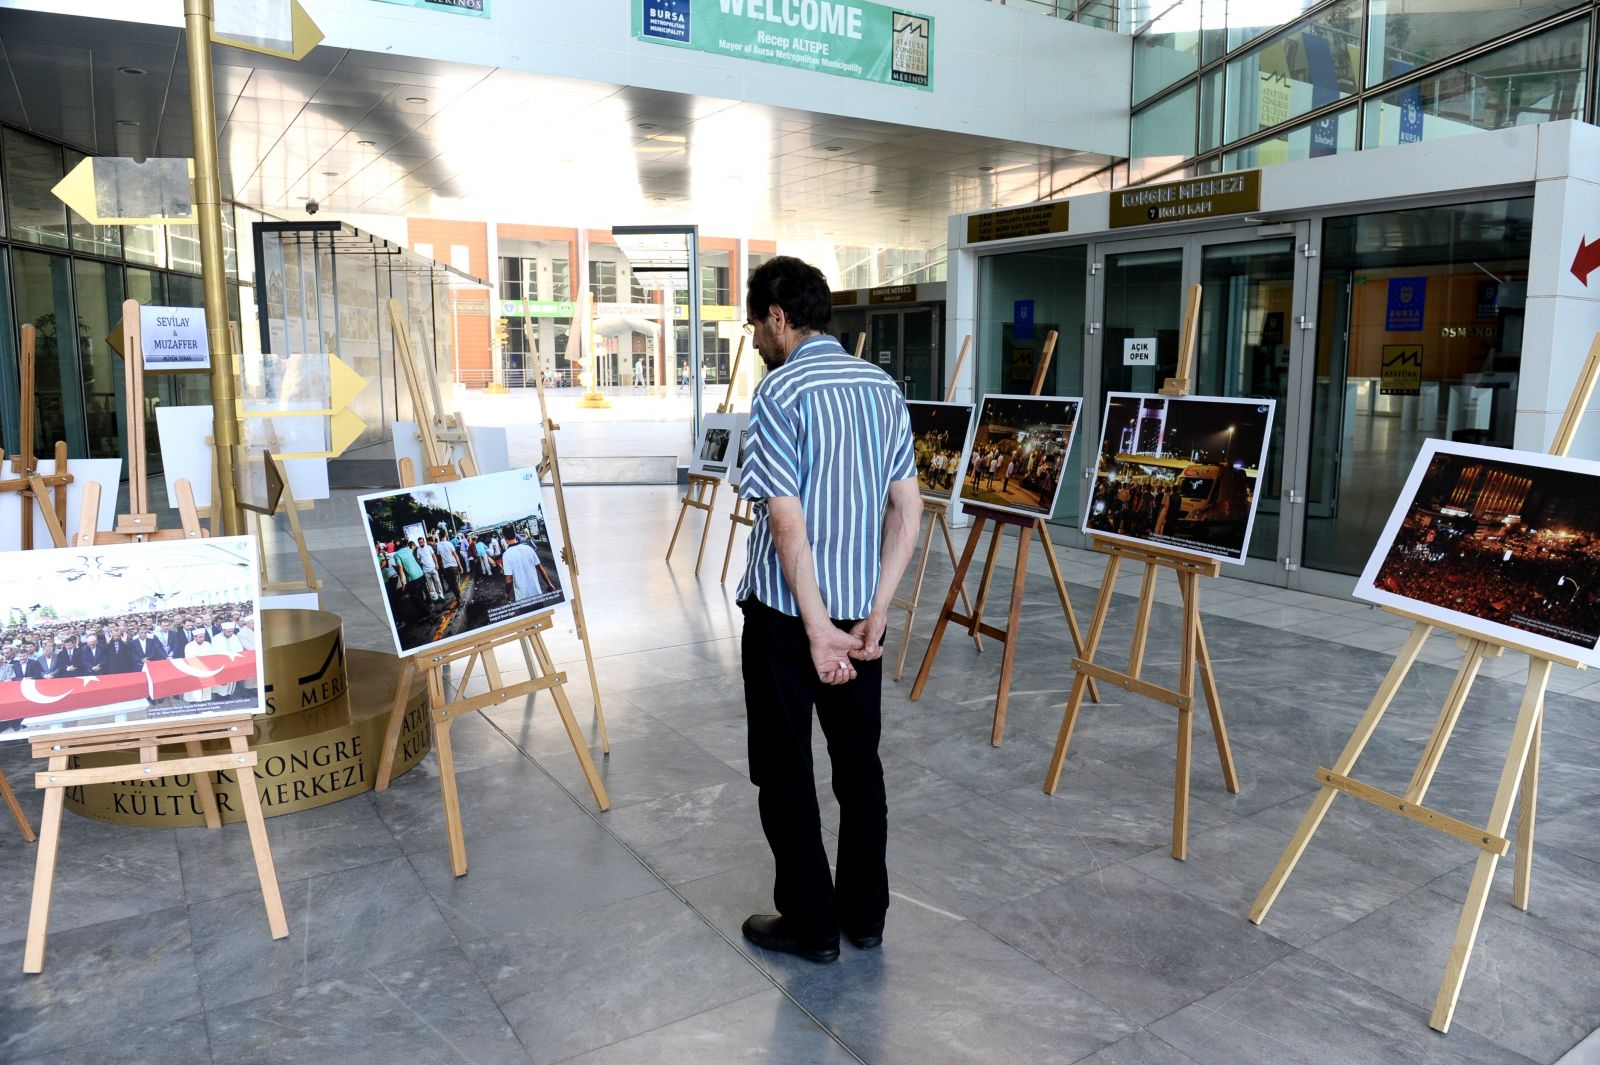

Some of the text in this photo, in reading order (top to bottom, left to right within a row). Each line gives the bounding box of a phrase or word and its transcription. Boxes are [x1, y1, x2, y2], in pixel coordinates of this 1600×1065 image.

[650, 8, 685, 22] BURSA
[718, 0, 863, 40] WELCOME
[650, 19, 685, 30] METROPOLITAN
[650, 25, 685, 36] MUNICIPALITY
[757, 30, 829, 56] Recep ALTEPE
[718, 39, 863, 75] Mayor of Bursa Metropolitan Municipality
[1122, 186, 1177, 208] KONGRE
[156, 315, 190, 328] SEVİLAY
[172, 329, 178, 337] &
[153, 339, 199, 350] MUZAFFER
[1131, 343, 1149, 352] AÇIK
[1130, 352, 1149, 361] OPEN
[259, 758, 366, 808] MERKEZİ
